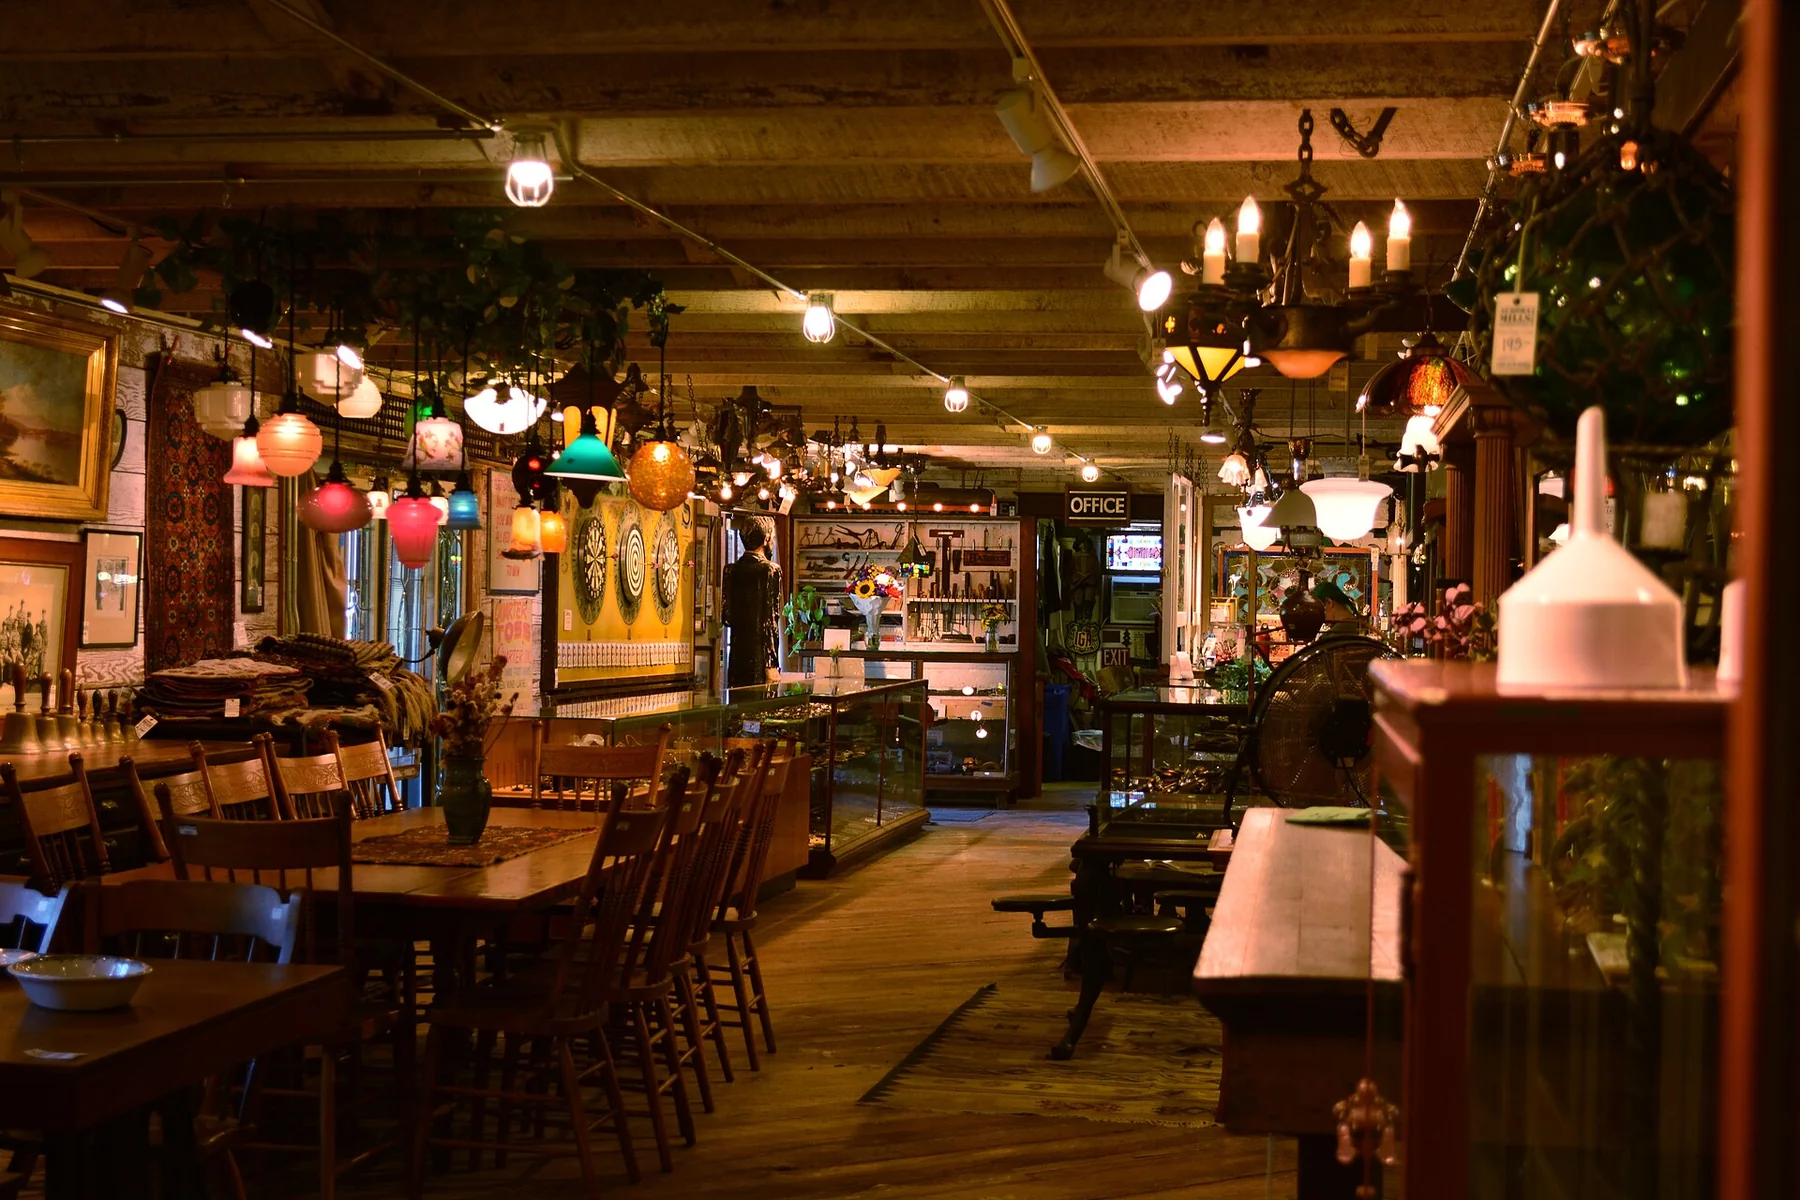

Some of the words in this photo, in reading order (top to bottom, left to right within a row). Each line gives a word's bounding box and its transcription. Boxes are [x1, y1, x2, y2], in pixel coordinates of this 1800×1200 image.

[1070, 496, 1125, 514] OFFICE
[496, 621, 531, 643] TOSS
[1074, 631, 1093, 648] IGA
[1103, 648, 1129, 666] EXIT
